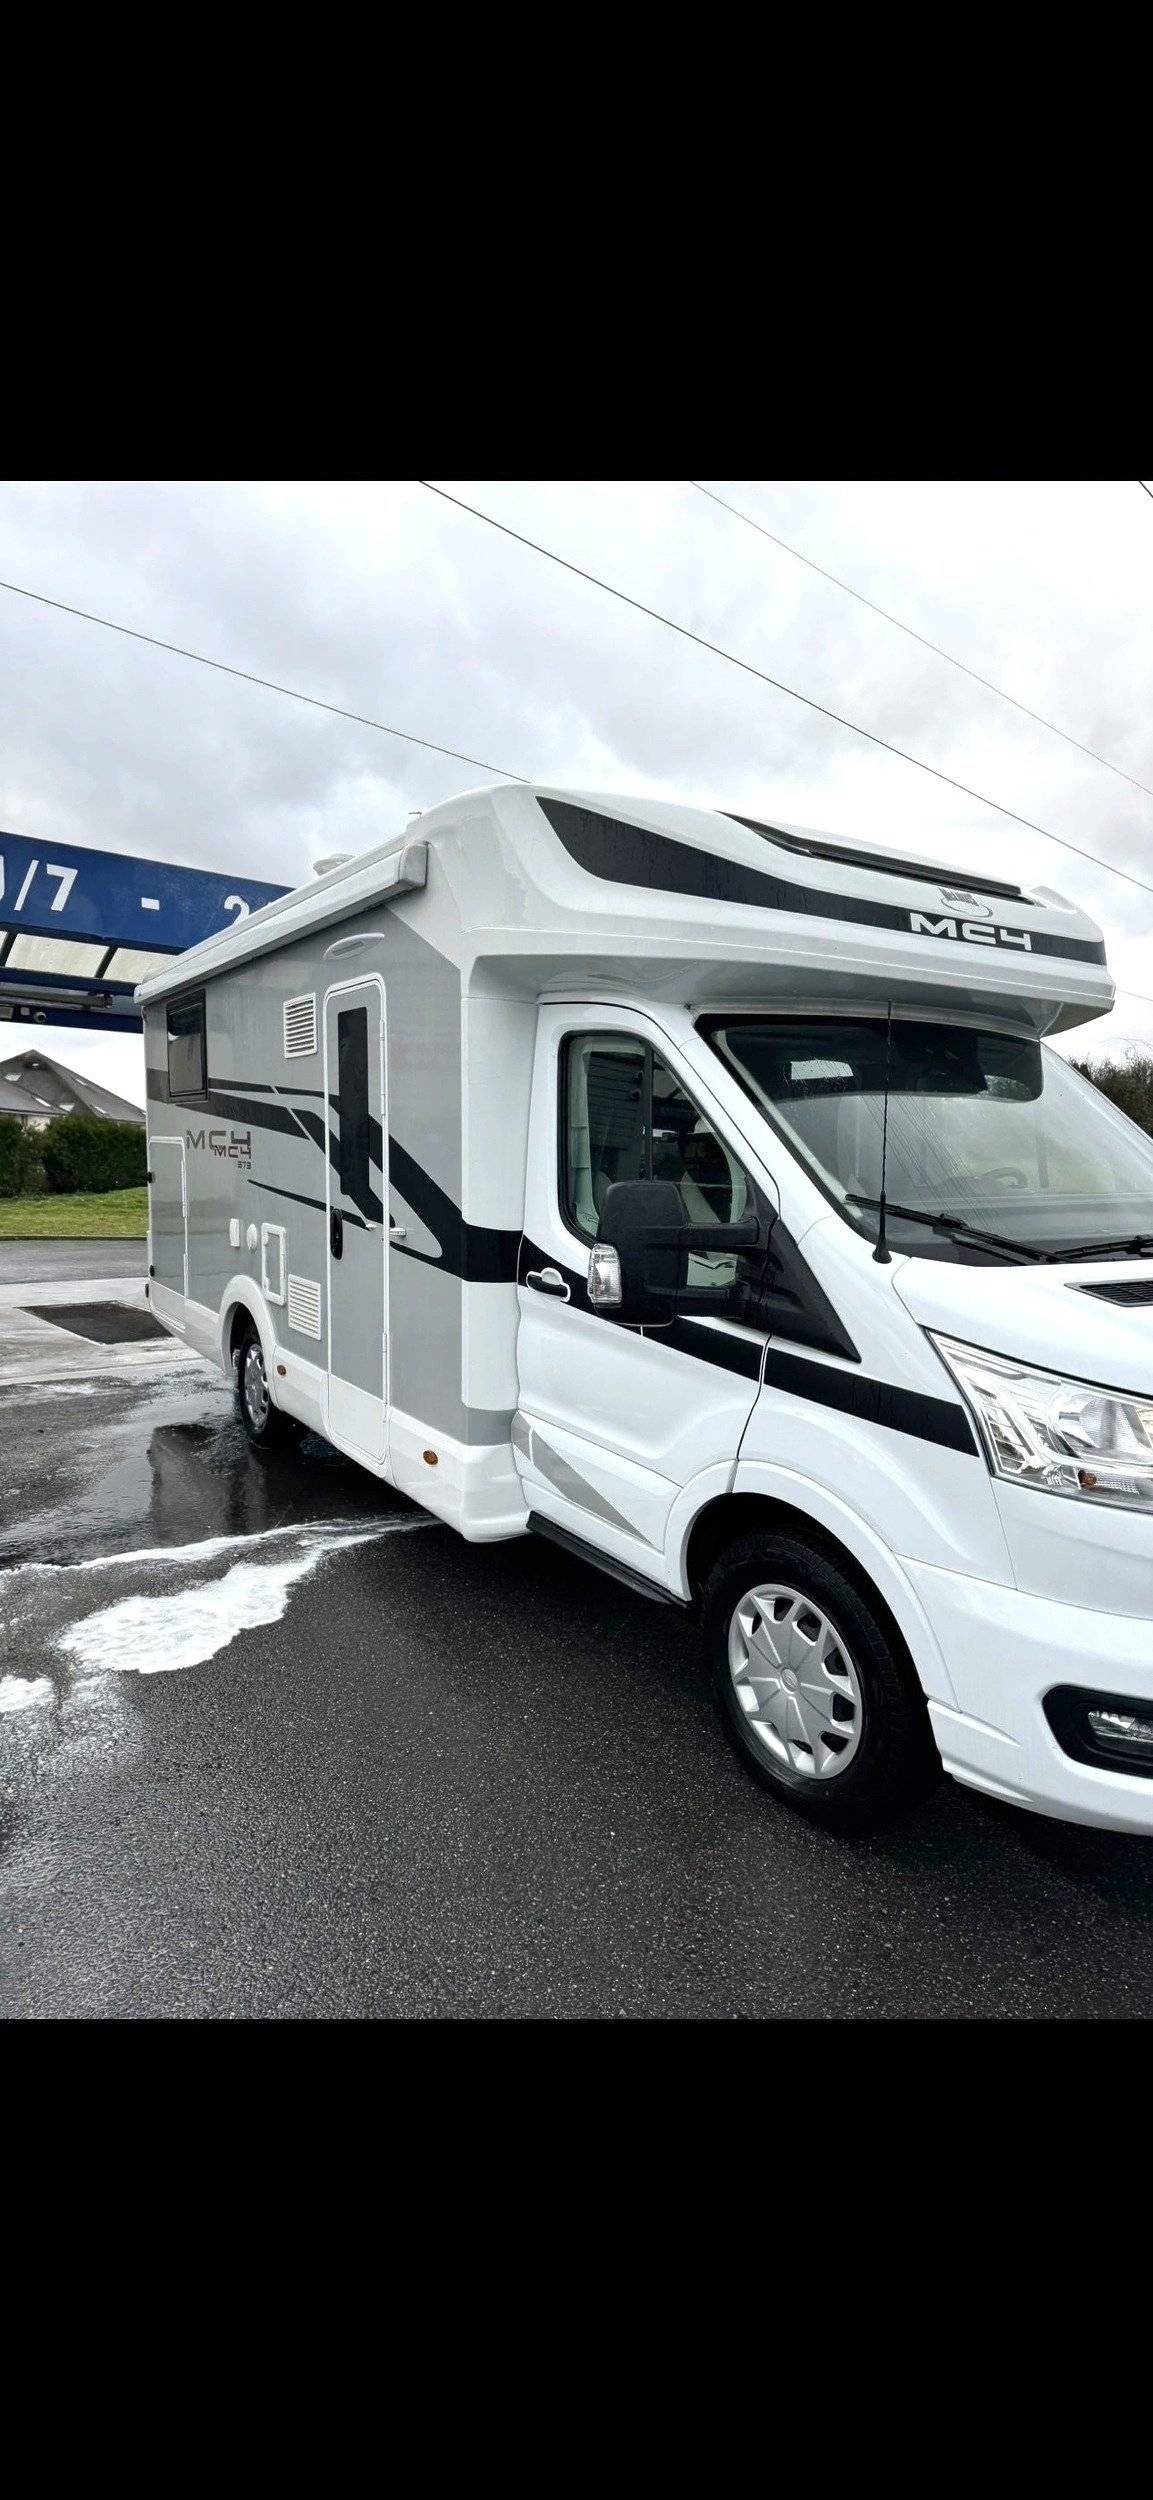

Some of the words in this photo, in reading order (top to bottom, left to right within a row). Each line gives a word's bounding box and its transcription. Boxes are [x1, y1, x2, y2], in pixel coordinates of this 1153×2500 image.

[0, 854, 78, 911] /7
[910, 912, 1032, 951] MC4
[186, 1130, 251, 1150] MC4
[214, 1145, 251, 1159] MC4
